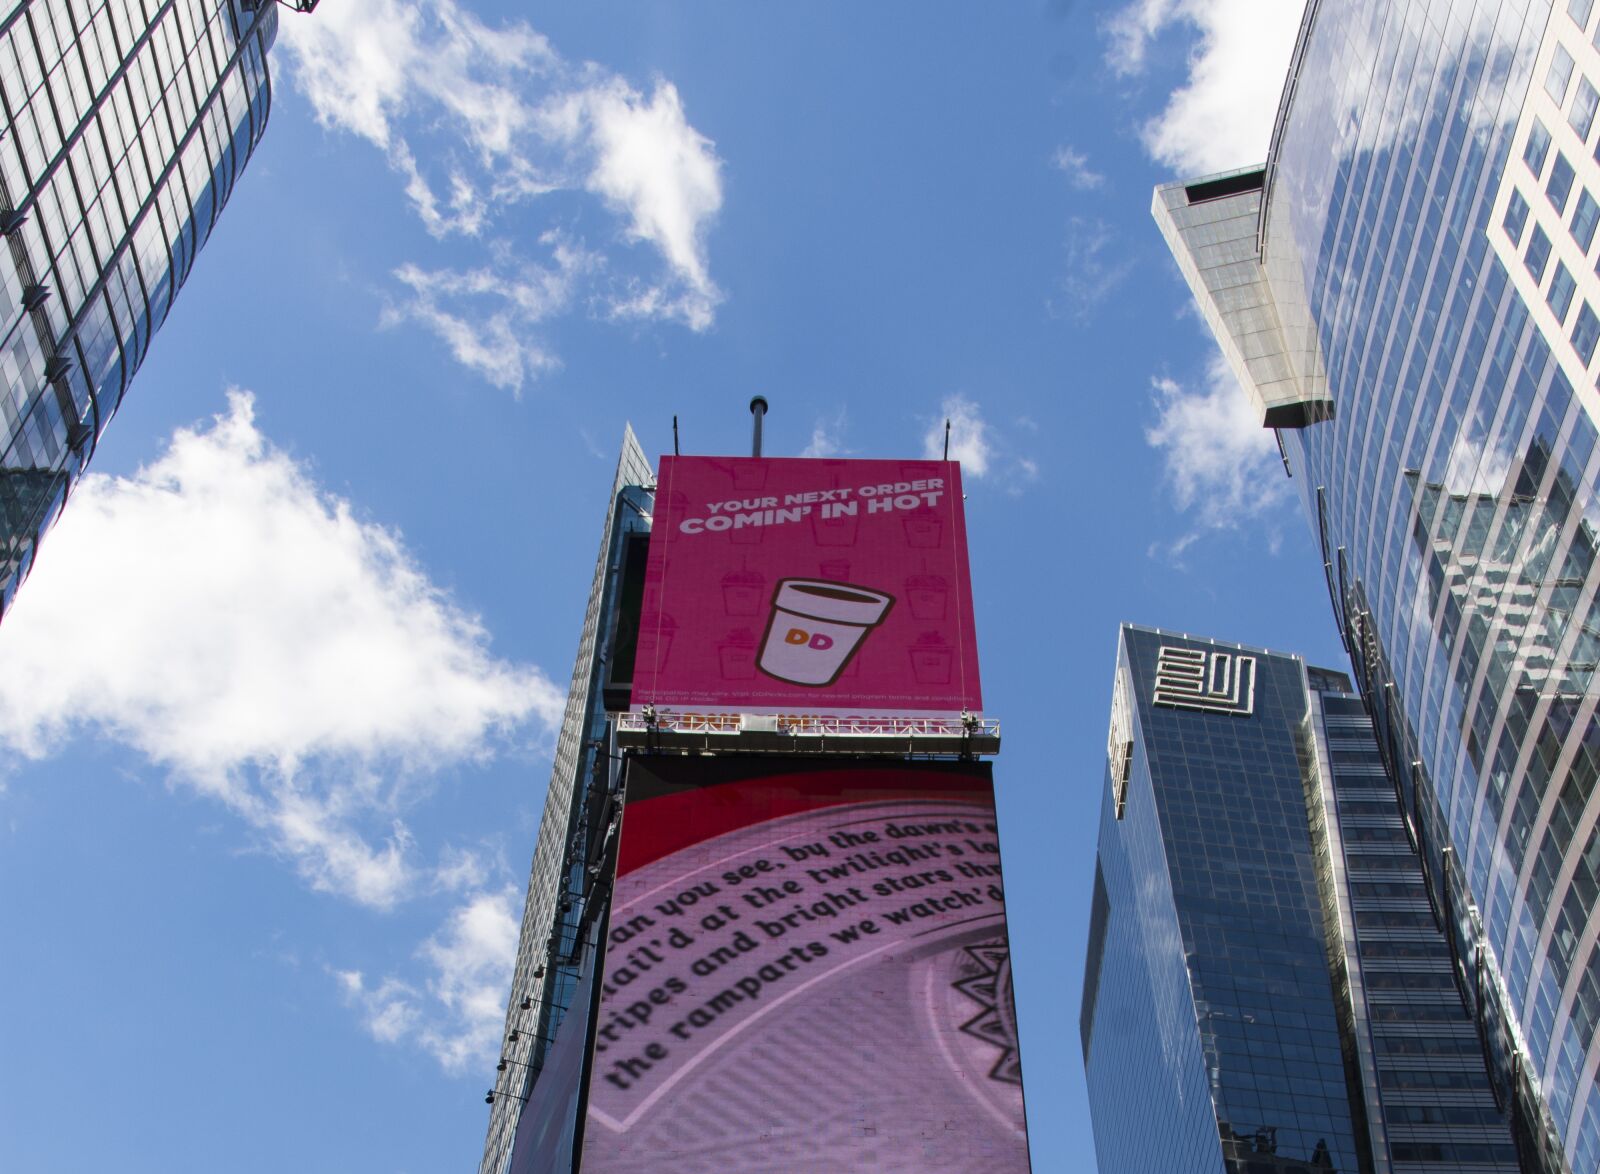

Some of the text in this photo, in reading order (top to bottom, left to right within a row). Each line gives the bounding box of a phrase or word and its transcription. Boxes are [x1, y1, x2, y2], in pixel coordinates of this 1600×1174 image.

[679, 490, 944, 534] COMIN' IN HOT
[706, 478, 945, 514] YOUR NEXT ORDER
[785, 628, 834, 651] DD
[607, 914, 656, 952] an
[654, 881, 721, 916] you
[721, 859, 787, 885] see,
[779, 841, 830, 862] by
[828, 831, 881, 849] the
[884, 819, 981, 839] dawn's
[701, 905, 740, 931] at
[742, 880, 804, 909] the
[805, 841, 965, 884] twilight's
[597, 976, 689, 1052] ripes
[691, 930, 760, 977] and
[753, 887, 870, 939] bright
[872, 869, 955, 896] stars
[605, 884, 1004, 1091] the ramparts we watch'd
